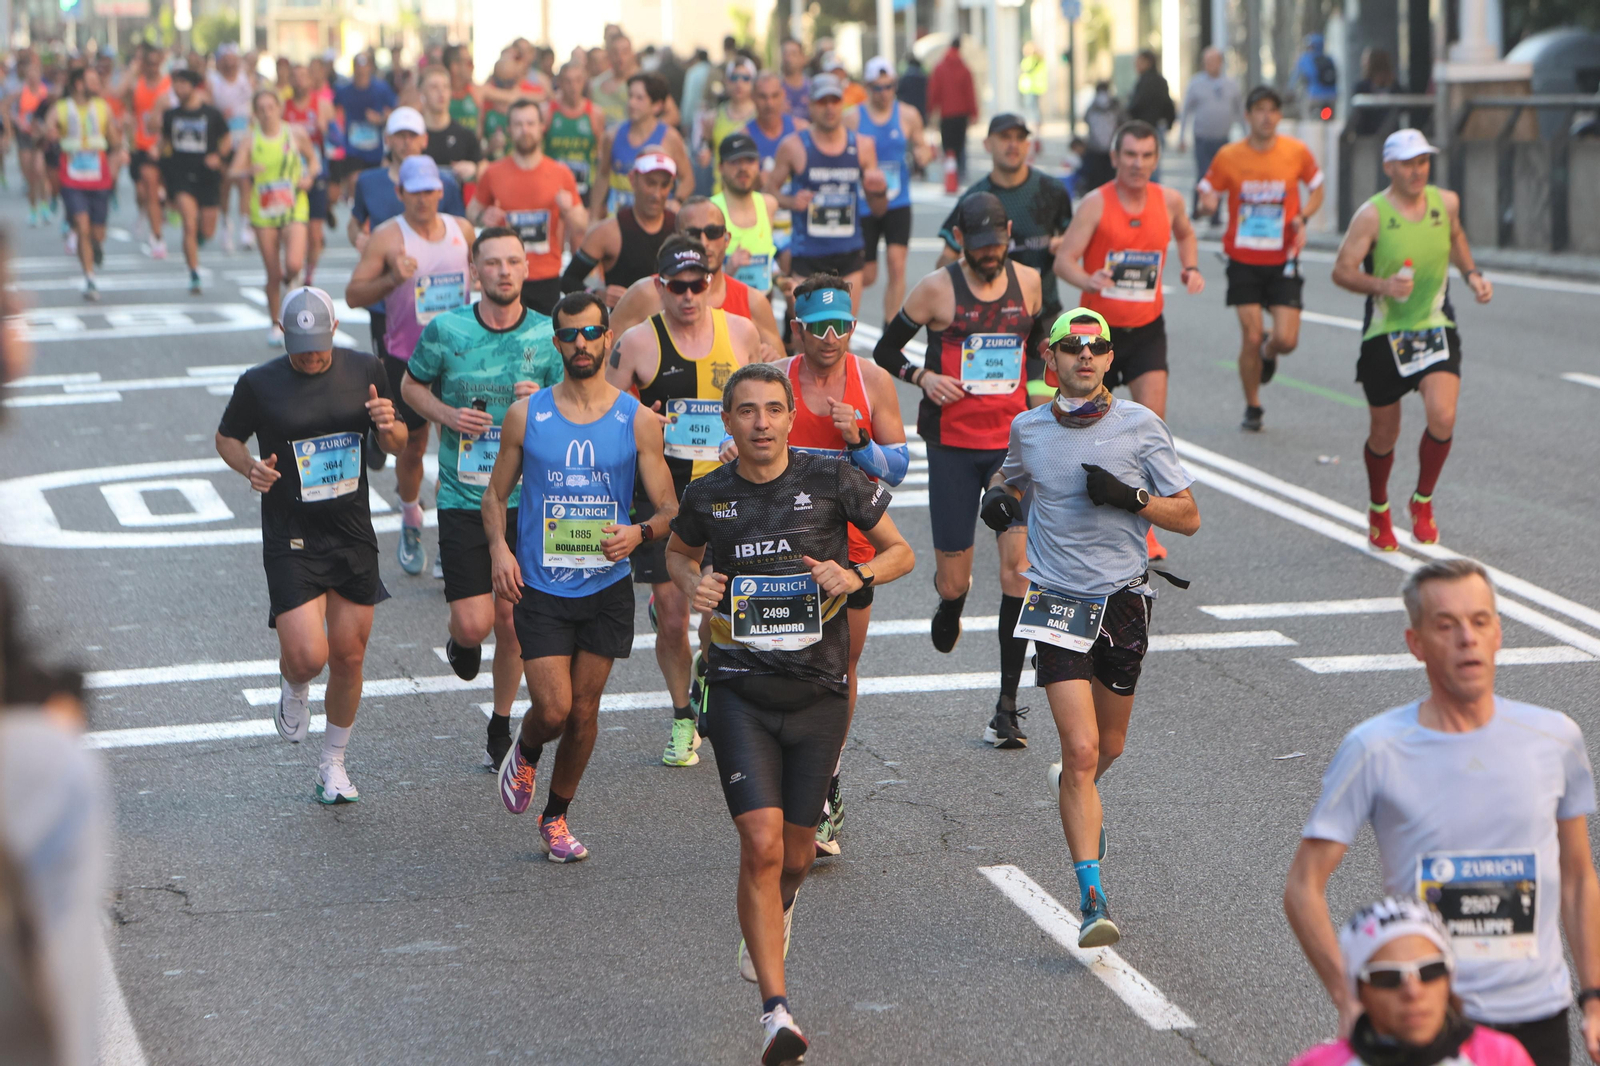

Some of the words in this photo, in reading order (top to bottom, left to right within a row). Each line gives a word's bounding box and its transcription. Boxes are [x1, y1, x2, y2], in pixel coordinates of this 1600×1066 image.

[985, 338, 1016, 348] ZURICH
[984, 358, 1004, 367] 4594
[689, 424, 710, 433] 4516
[320, 436, 352, 450] ZURICH
[484, 450, 497, 460] 363
[323, 459, 342, 471] 3644
[478, 464, 492, 472] ANT
[570, 508, 607, 516] ZURICH
[712, 502, 728, 512] 10K
[712, 509, 738, 518] IBIZA
[570, 529, 592, 539] 1885
[556, 544, 602, 552] BOUABDELA
[735, 538, 792, 558] IBIZA
[762, 580, 806, 592] ZURICH
[762, 607, 790, 618] 2499
[1050, 604, 1075, 618] 3213
[750, 623, 805, 634] ALEJANDRO
[1047, 618, 1070, 632] RAÚL
[1461, 858, 1524, 878] ZURICH
